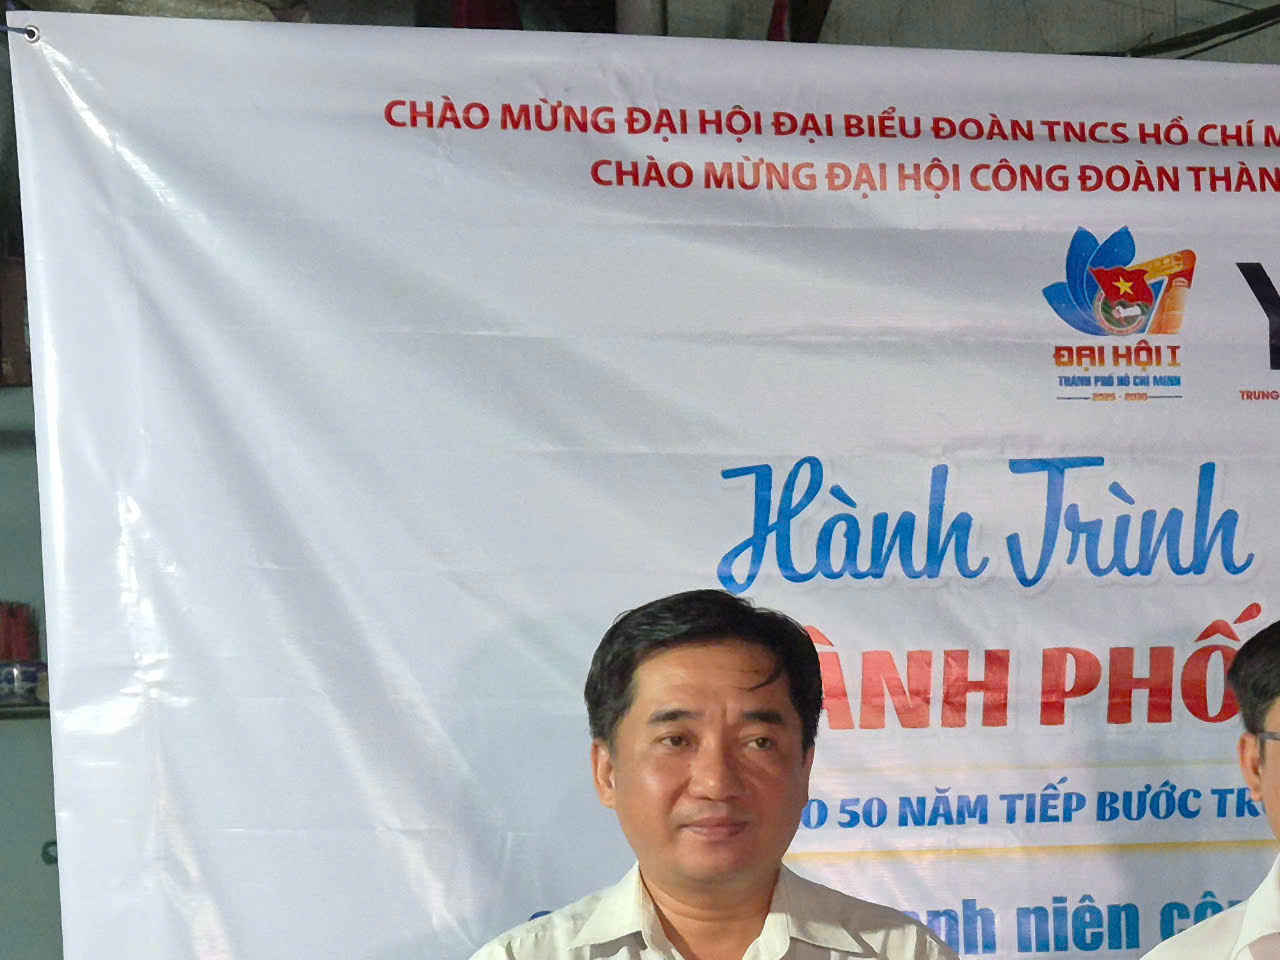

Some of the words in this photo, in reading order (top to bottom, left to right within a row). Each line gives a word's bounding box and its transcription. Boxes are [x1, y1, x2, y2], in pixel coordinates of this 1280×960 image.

[384, 96, 490, 131] CHÀO
[501, 99, 616, 135] MỪNG
[624, 107, 688, 143] ĐẠI
[699, 106, 762, 144] HỘI
[771, 112, 833, 144] ĐẠI
[844, 107, 922, 139] BIỂU
[931, 114, 1034, 141] ĐOÀN
[1041, 121, 1129, 145] TNCS
[1138, 117, 1189, 145] HỒ
[1197, 120, 1254, 147] CHÍ
[590, 156, 694, 188] CHÀO
[703, 157, 817, 191] MỪNG
[825, 162, 888, 199] ĐẠI
[898, 159, 961, 199] HỘI
[969, 159, 1070, 192] CÔNG
[1078, 160, 1180, 193] ĐOÀN
[1053, 345, 1105, 371] ĐẠI
[1112, 339, 1162, 371] HỘI
[1240, 390, 1280, 400] TRUNG
[717, 455, 990, 594] Hành
[1006, 455, 1254, 588] Trình
[804, 625, 1010, 730] ÀNH
[1040, 602, 1261, 726] PHỐ
[837, 796, 888, 829] 50
[897, 786, 988, 826] NĂM
[1000, 777, 1086, 825] TIẾP
[1096, 779, 1202, 822] BƯỚC
[1016, 894, 1140, 954] niên
